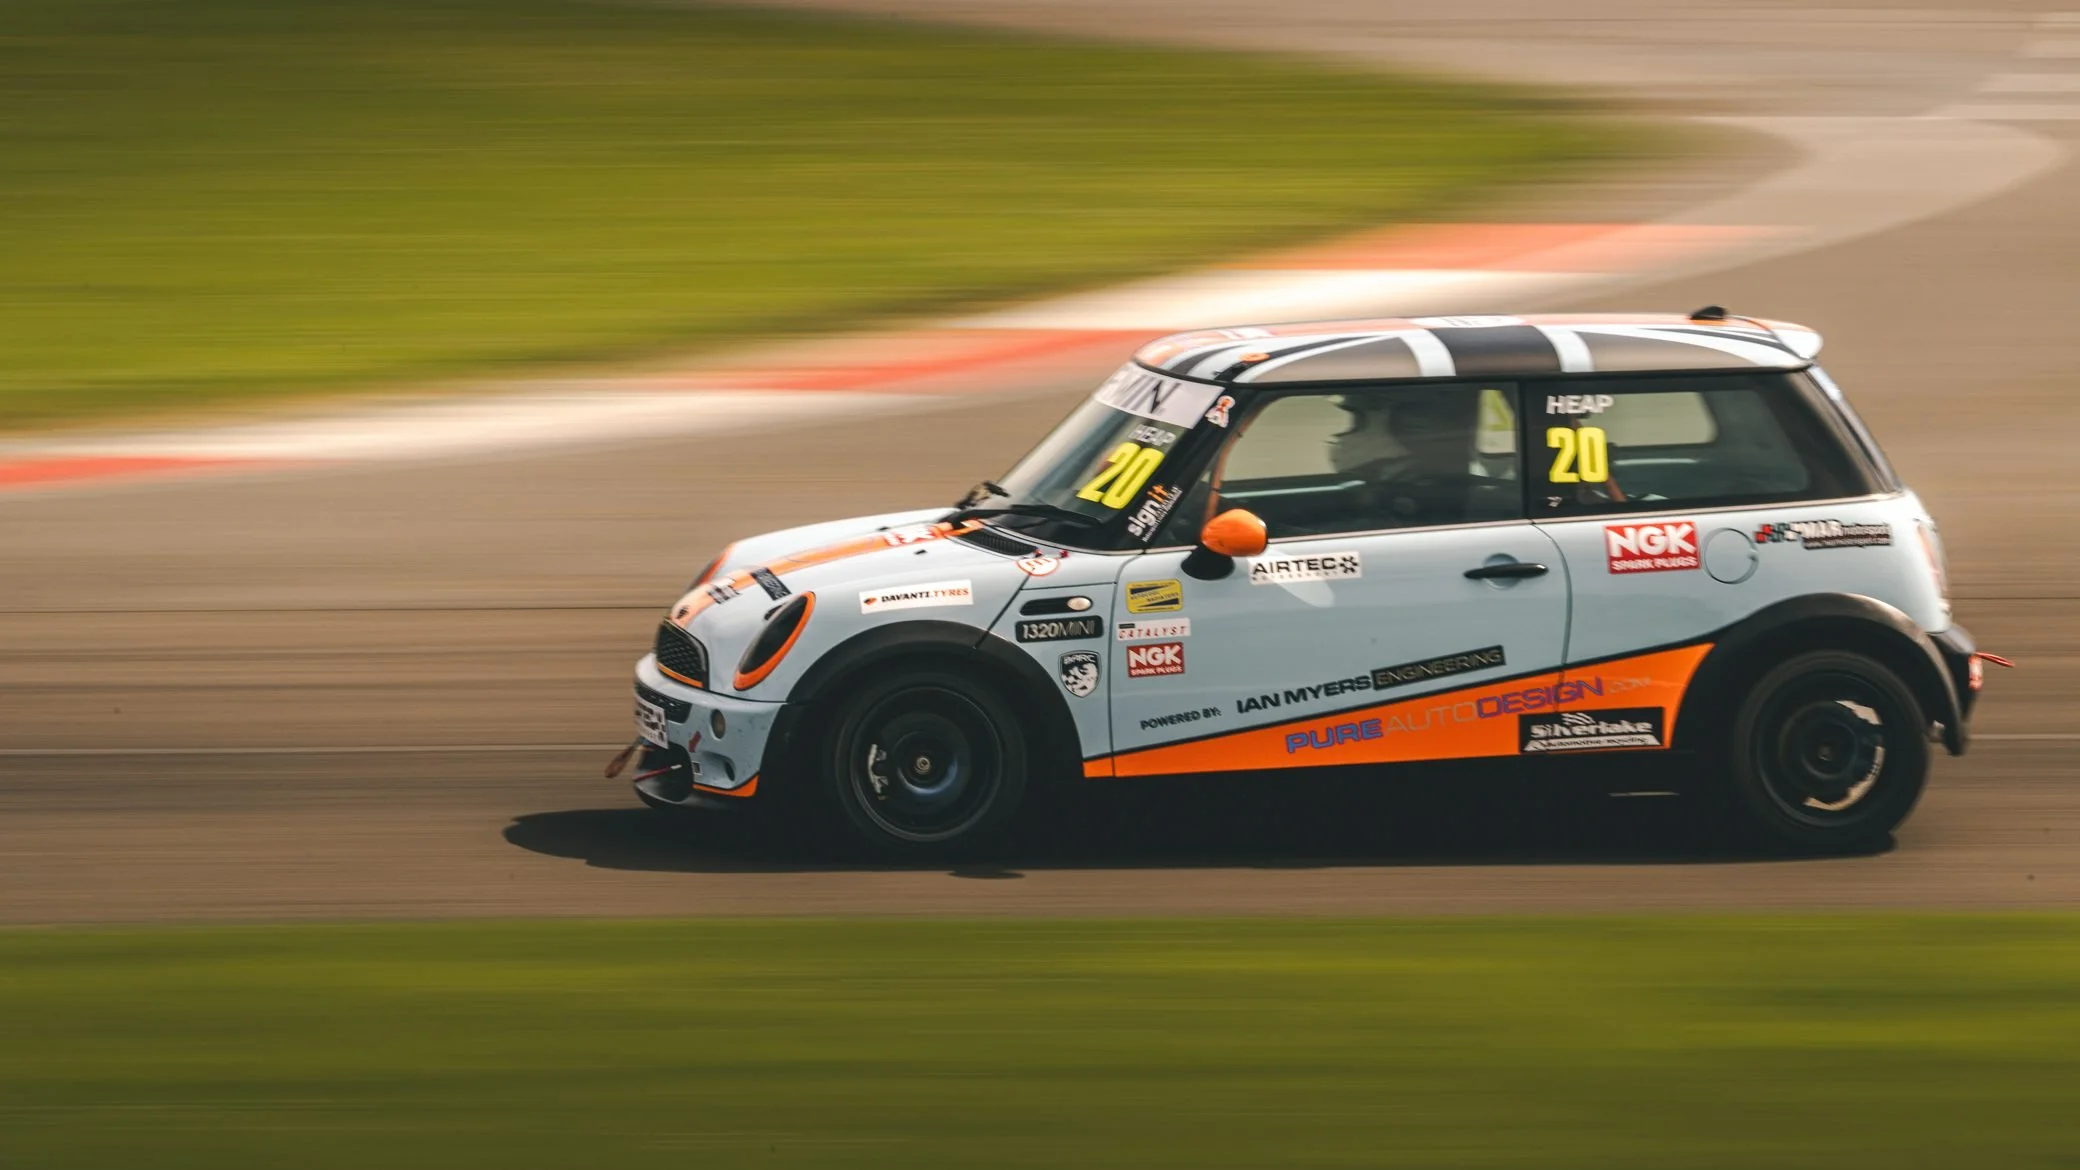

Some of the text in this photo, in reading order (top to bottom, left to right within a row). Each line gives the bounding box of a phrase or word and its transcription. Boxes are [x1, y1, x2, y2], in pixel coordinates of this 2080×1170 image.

[1546, 394, 1614, 414] HEAP
[1546, 427, 1608, 483] 20
[1075, 442, 1165, 510] 20
[1605, 523, 1697, 557] NGK
[1253, 557, 1336, 575] AIRTEC
[1611, 556, 1699, 571] SPARK PLUGS
[1023, 620, 1095, 640] 1320MINI
[1119, 625, 1187, 639] CATALYST
[1128, 645, 1182, 668] NGK
[1140, 709, 1201, 730] POWERED
[1237, 692, 1281, 714] IAN
[1284, 675, 1371, 706] MYERS
[1376, 648, 1503, 687] ENGINEERING
